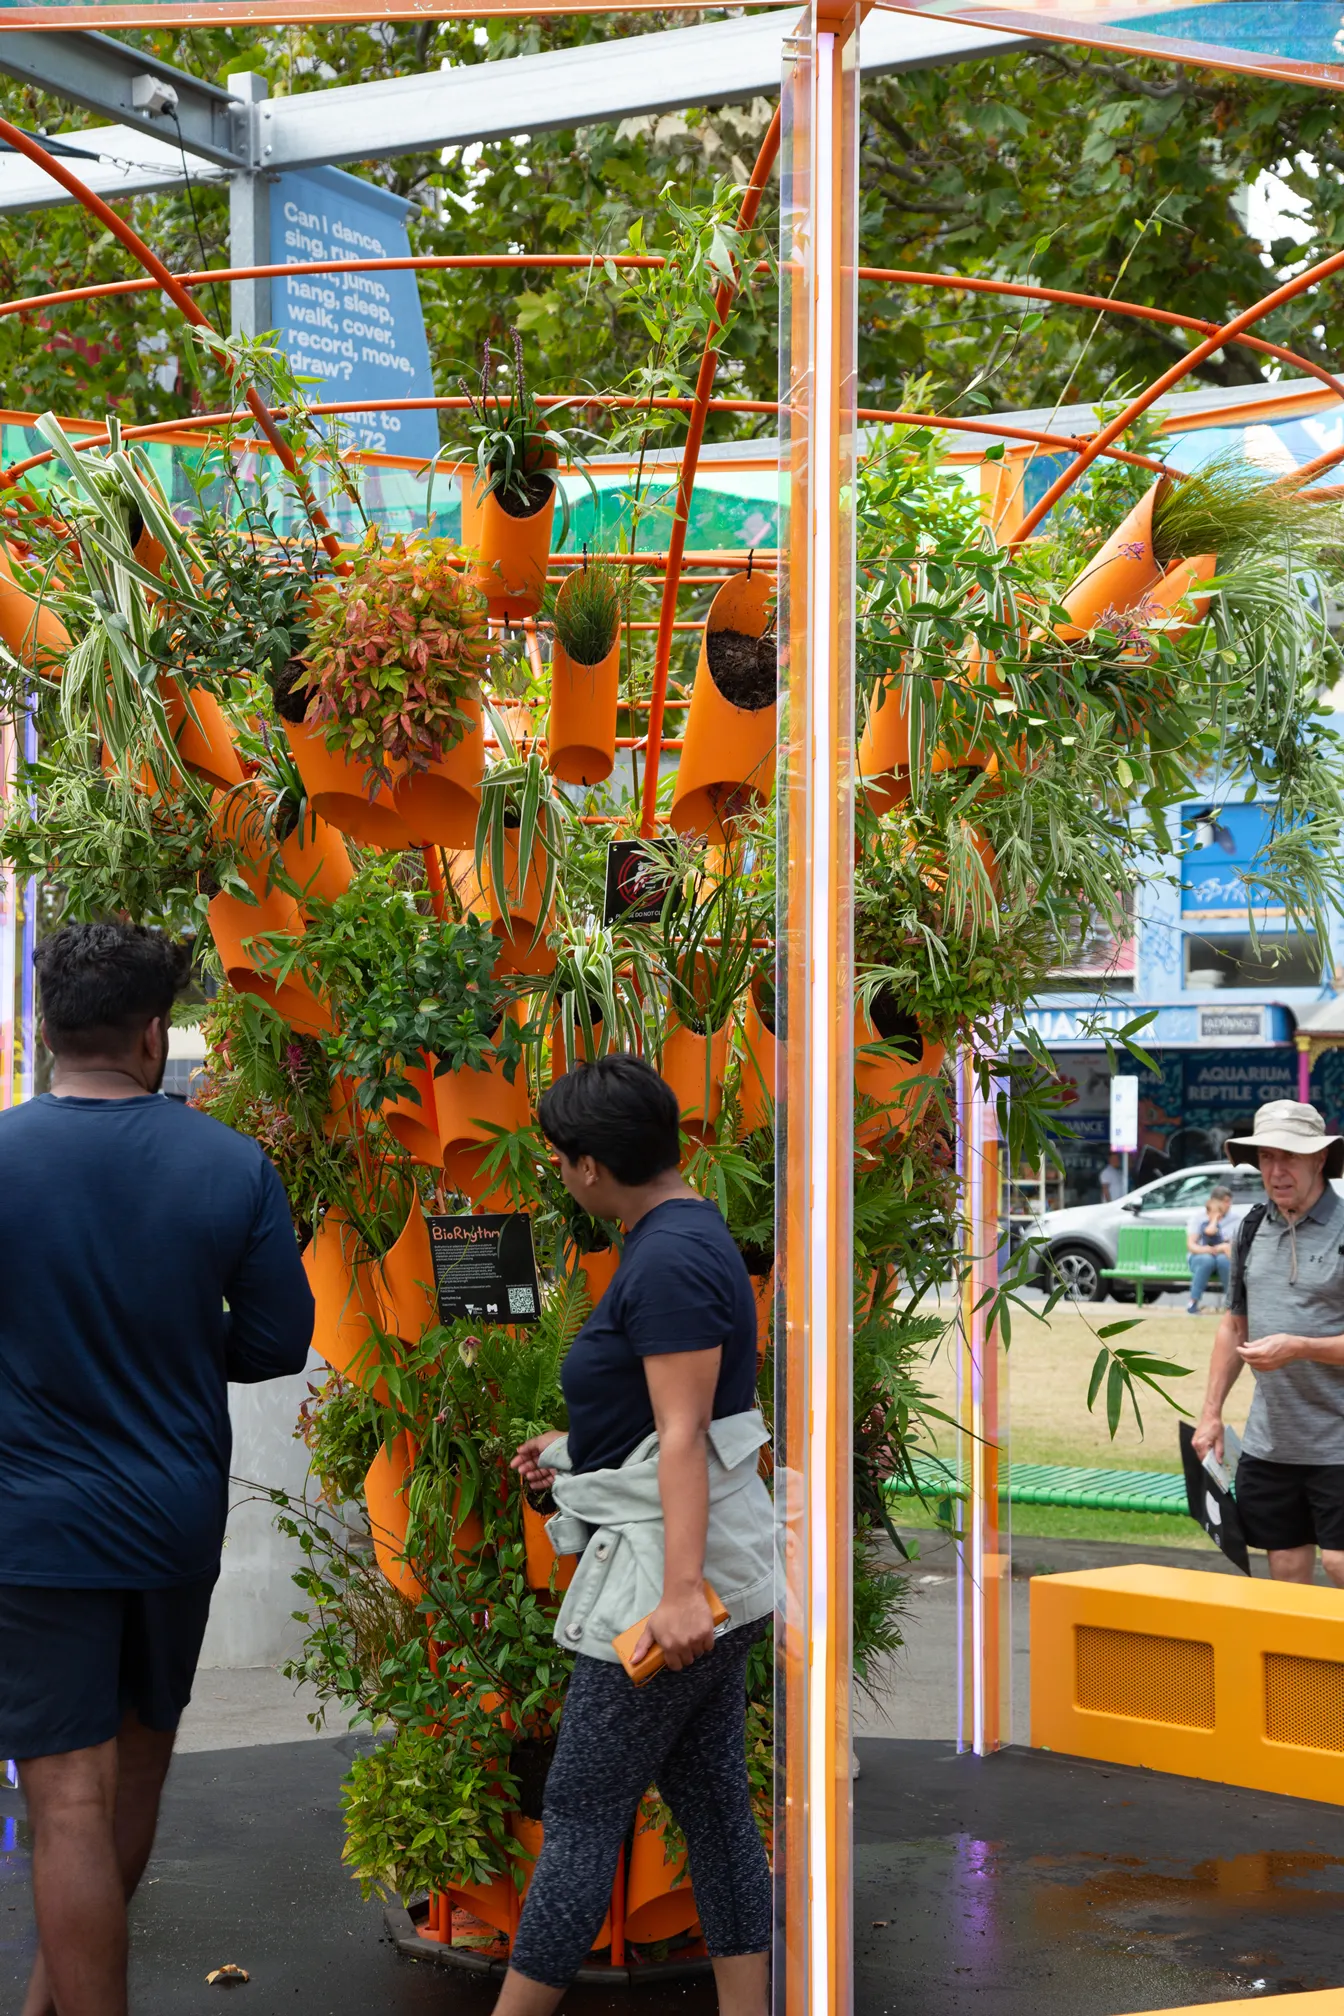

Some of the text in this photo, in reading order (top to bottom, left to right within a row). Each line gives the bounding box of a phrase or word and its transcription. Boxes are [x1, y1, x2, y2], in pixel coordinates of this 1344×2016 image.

[284, 202, 387, 258] Can I dance,
[285, 228, 328, 260] sing,
[287, 275, 395, 326] hang, sleep,
[342, 271, 390, 303] jump,
[288, 303, 396, 349] walk, cover,
[288, 328, 415, 377] record, move,
[289, 350, 354, 381] draw?
[381, 411, 402, 432] to
[1197, 1066, 1292, 1083] AQUARIUM
[1188, 1086, 1322, 1101] REPTILE CENTE
[432, 1226, 500, 1242] BioRhythm
